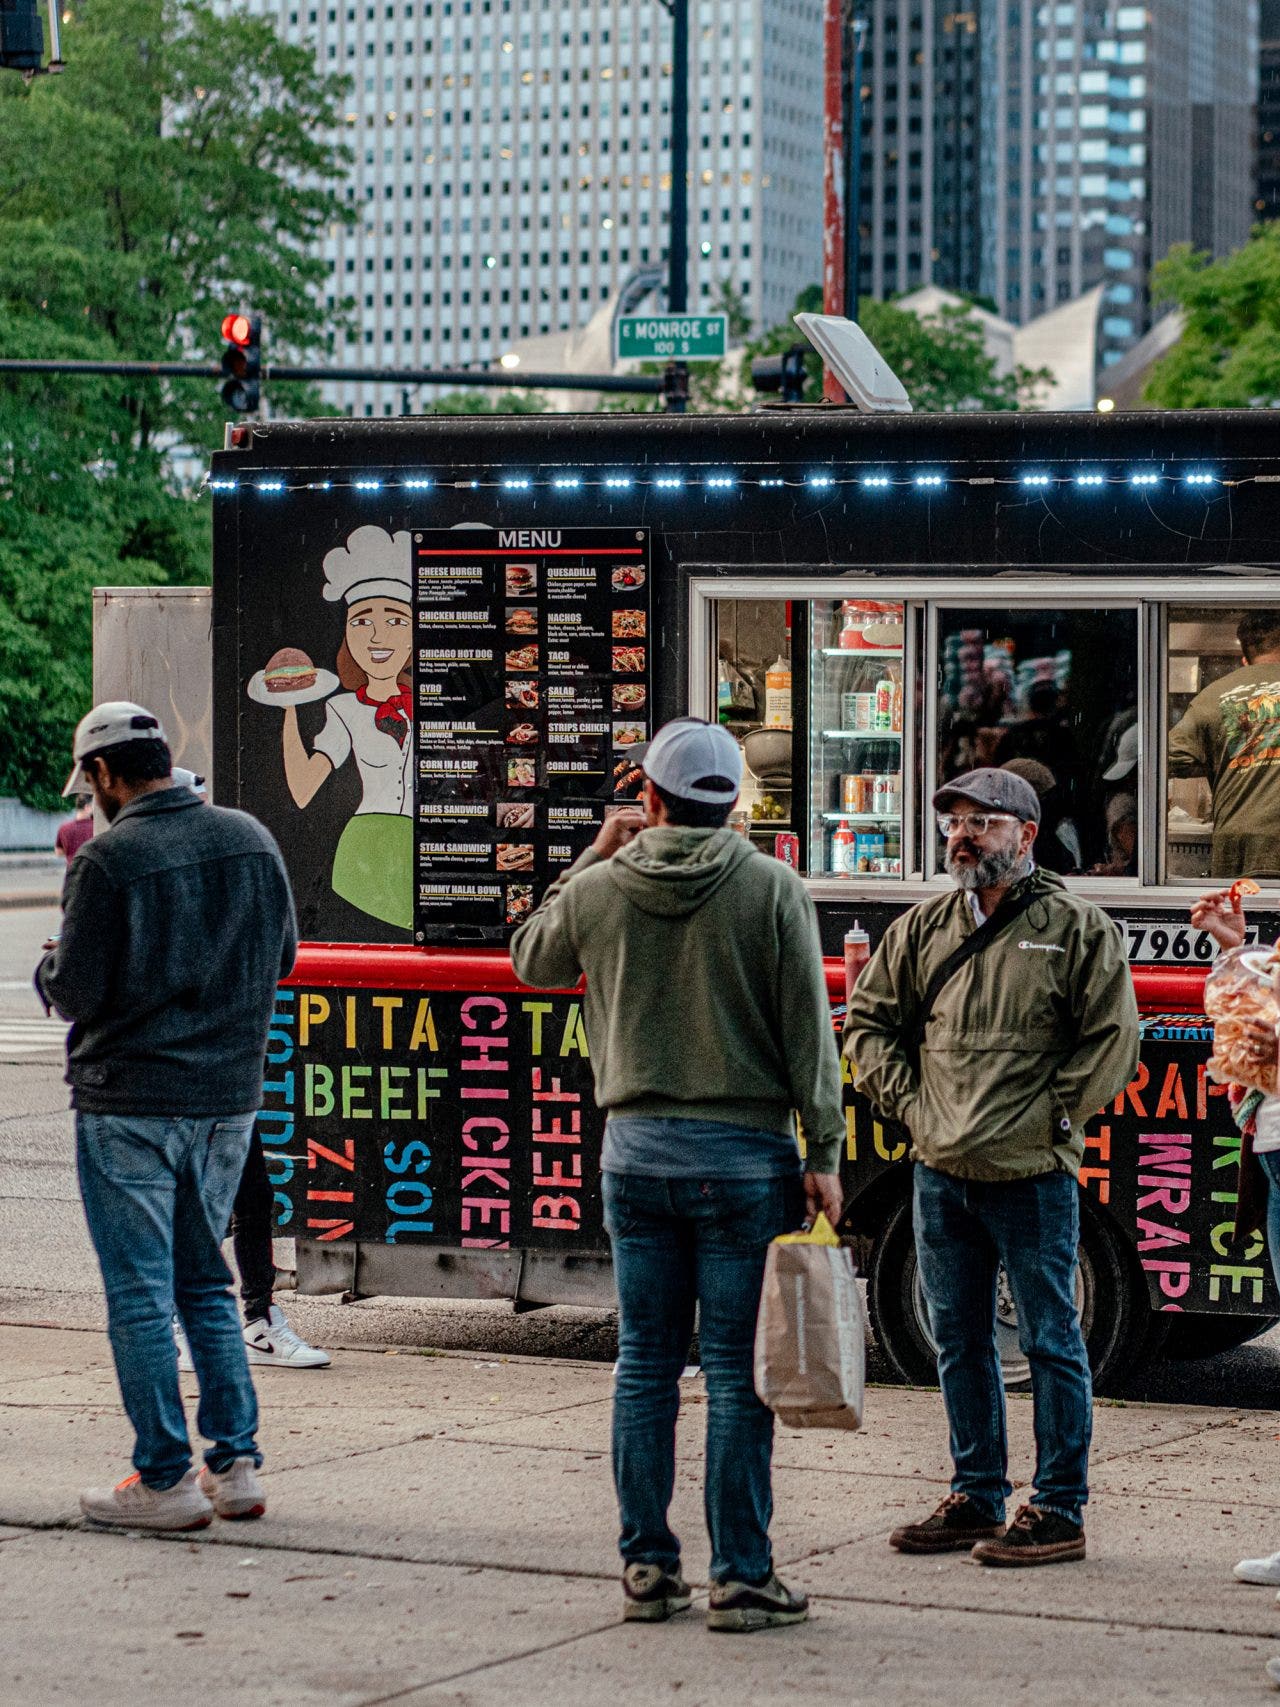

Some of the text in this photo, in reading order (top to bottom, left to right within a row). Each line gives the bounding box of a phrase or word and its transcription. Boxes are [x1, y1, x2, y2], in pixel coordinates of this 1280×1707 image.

[623, 321, 720, 339] E MONROE ST
[654, 341, 690, 354] 100 S
[498, 531, 562, 548] MENU
[419, 567, 482, 576] CHEESE BURGER
[547, 568, 596, 577] QUESADILLA
[419, 612, 488, 620] CHICKEN BURGER
[548, 614, 582, 622] NACHOS
[420, 650, 492, 658] CHICAGO HOT DOG
[548, 652, 570, 660] TACO
[420, 684, 442, 693] GYRO
[548, 686, 575, 695] SALAD
[420, 722, 476, 730] YUMMY HALAL
[548, 724, 610, 732] STRIPS CHIKEN
[548, 734, 580, 744] BREAST
[420, 760, 478, 769] CORN IN A CUP
[546, 762, 588, 770] CORN DOG
[420, 805, 488, 814] FRIES SANDWICH
[548, 808, 593, 817] RICE BOWL
[420, 844, 492, 852] STEAK SANDWICH
[548, 846, 572, 855] FRIES
[420, 885, 502, 894] YUMMY HALAL BOWL
[300, 994, 439, 1051] PITA
[305, 1064, 448, 1119] BEEF
[1097, 1060, 1228, 1120] RAP
[532, 1067, 582, 1230] BEEF
